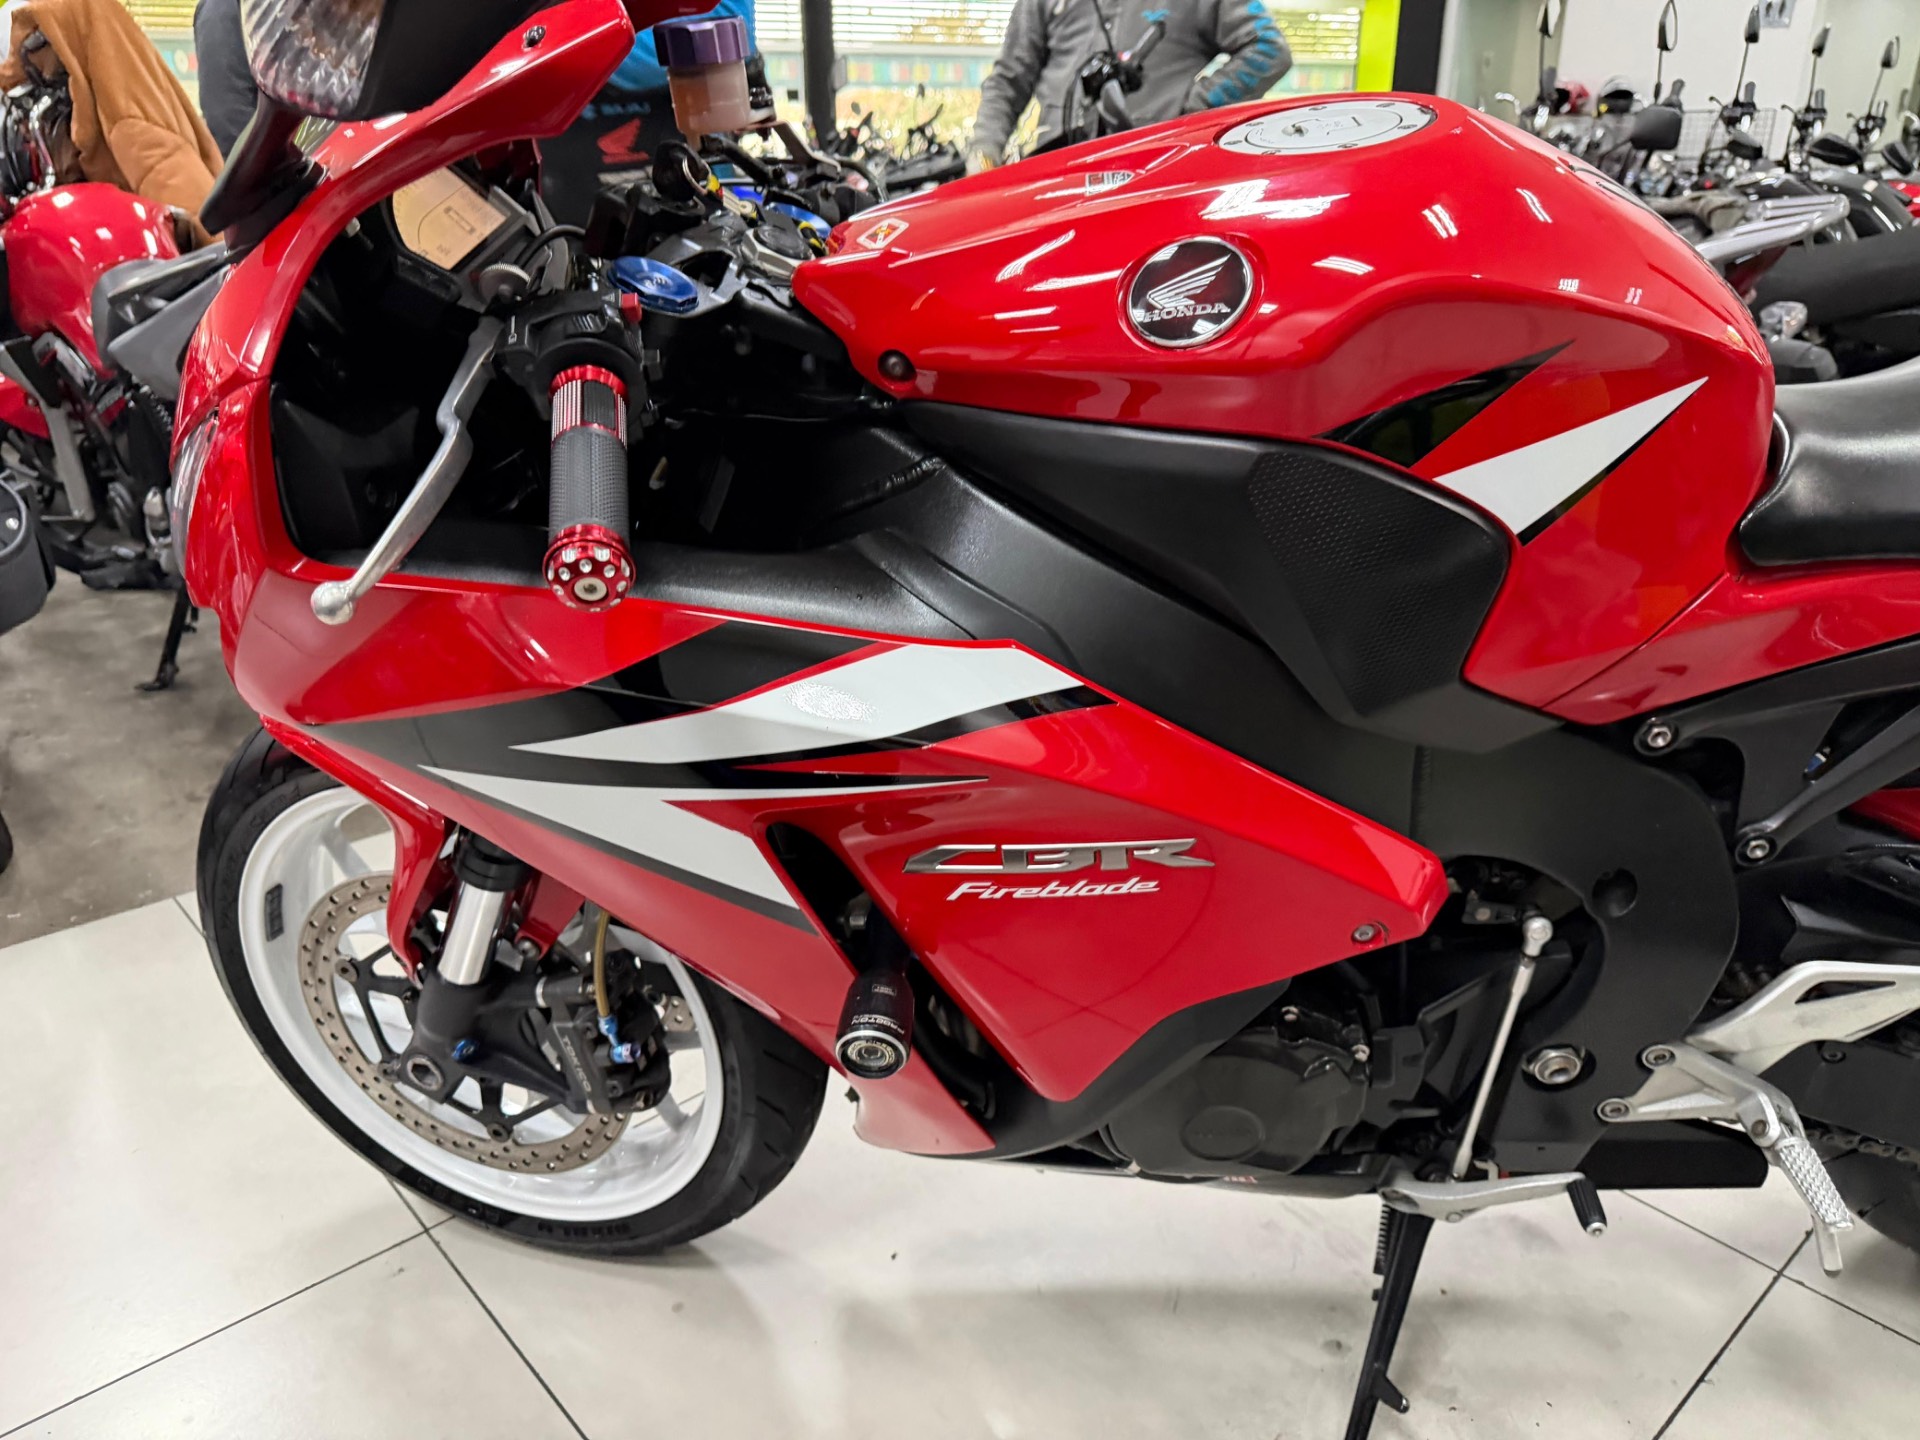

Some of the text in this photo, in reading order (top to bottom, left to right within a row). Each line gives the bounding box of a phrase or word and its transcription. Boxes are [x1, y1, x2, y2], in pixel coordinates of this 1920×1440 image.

[1143, 303, 1231, 322] HONDA
[903, 838, 1215, 873] CBR
[946, 876, 1160, 901] Fireblade
